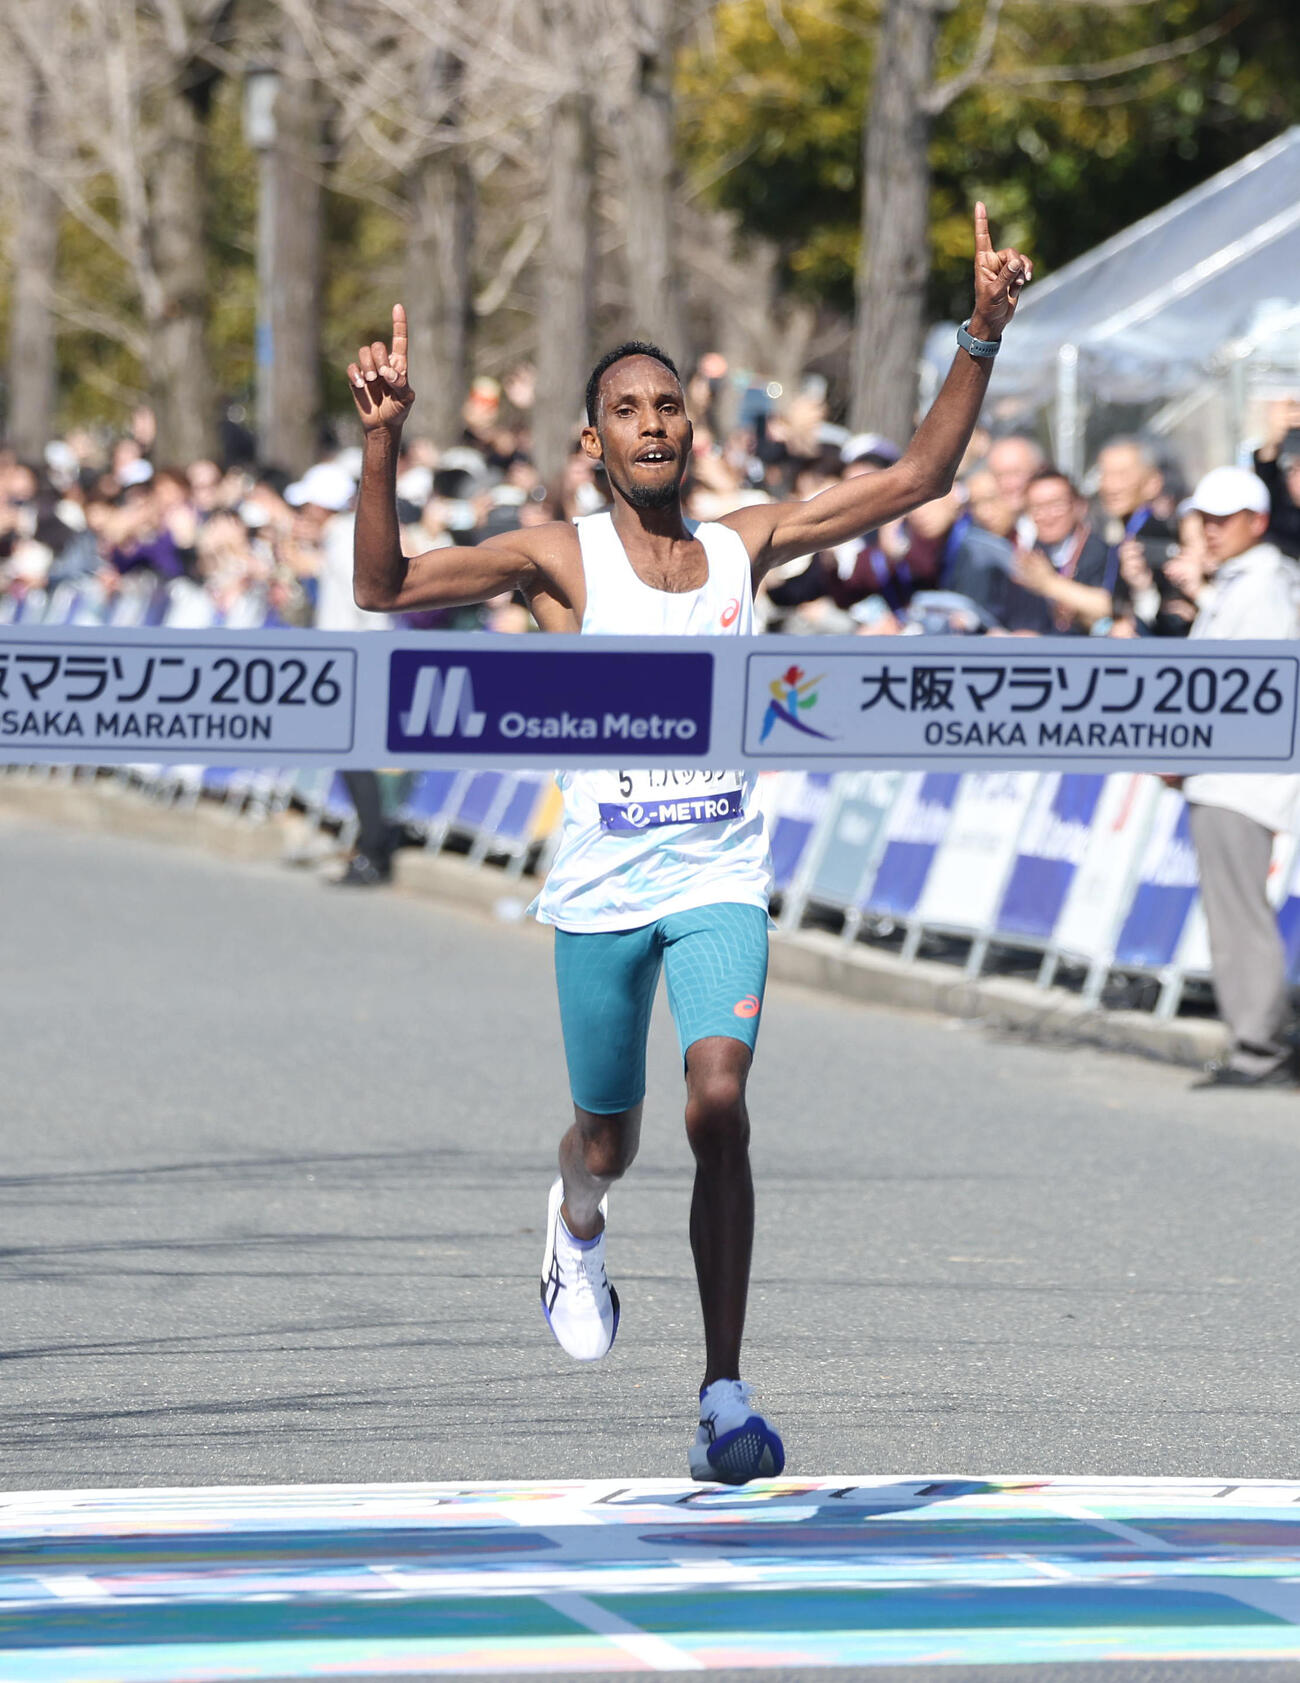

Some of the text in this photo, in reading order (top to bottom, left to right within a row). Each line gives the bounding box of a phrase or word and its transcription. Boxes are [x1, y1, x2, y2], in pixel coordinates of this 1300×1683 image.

[0, 655, 341, 706] マラソン2026
[861, 666, 1283, 714] 大阪マラソン2026
[0, 710, 272, 740] SAKA MARATHON
[499, 712, 698, 740] Osaka Metro
[925, 721, 1214, 749] OSAKA MARATHON
